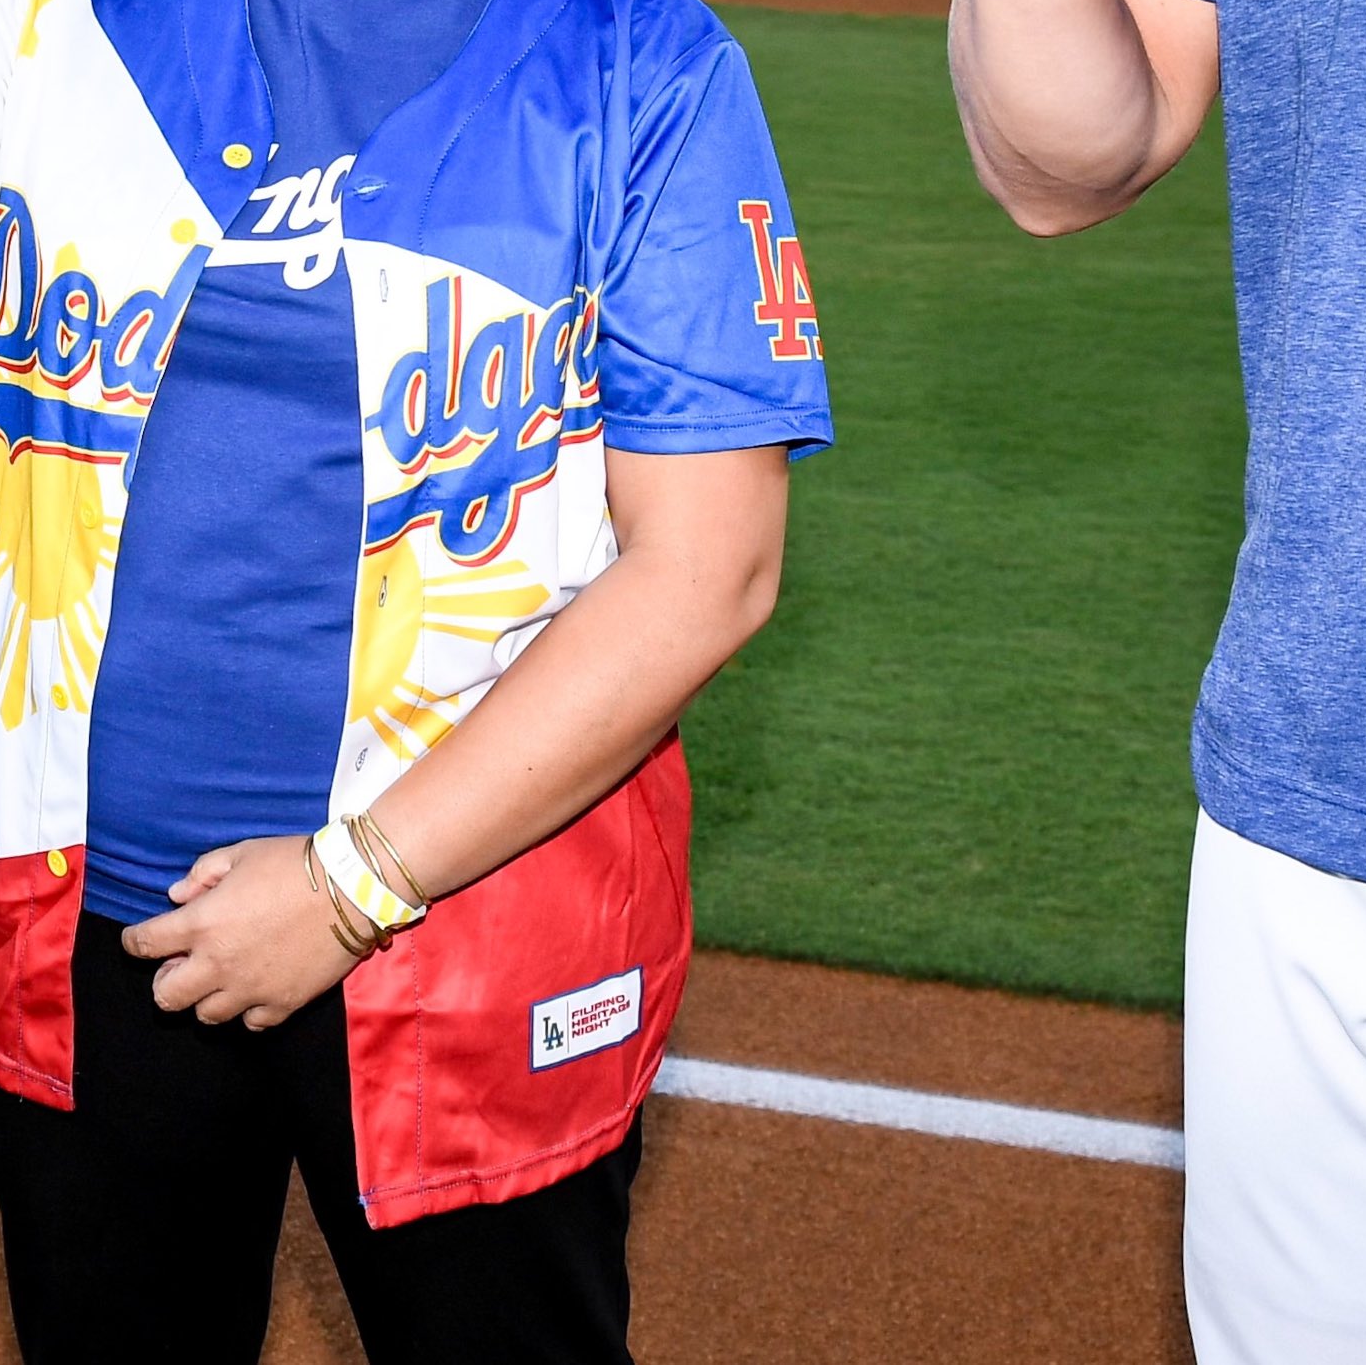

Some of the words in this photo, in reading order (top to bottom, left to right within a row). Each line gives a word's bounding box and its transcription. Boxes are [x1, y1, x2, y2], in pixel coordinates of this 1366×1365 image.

[738, 200, 825, 361] LA
[572, 995, 625, 1020] FILIPINO
[543, 1016, 564, 1051] LA
[572, 1018, 611, 1038] NIGHT
